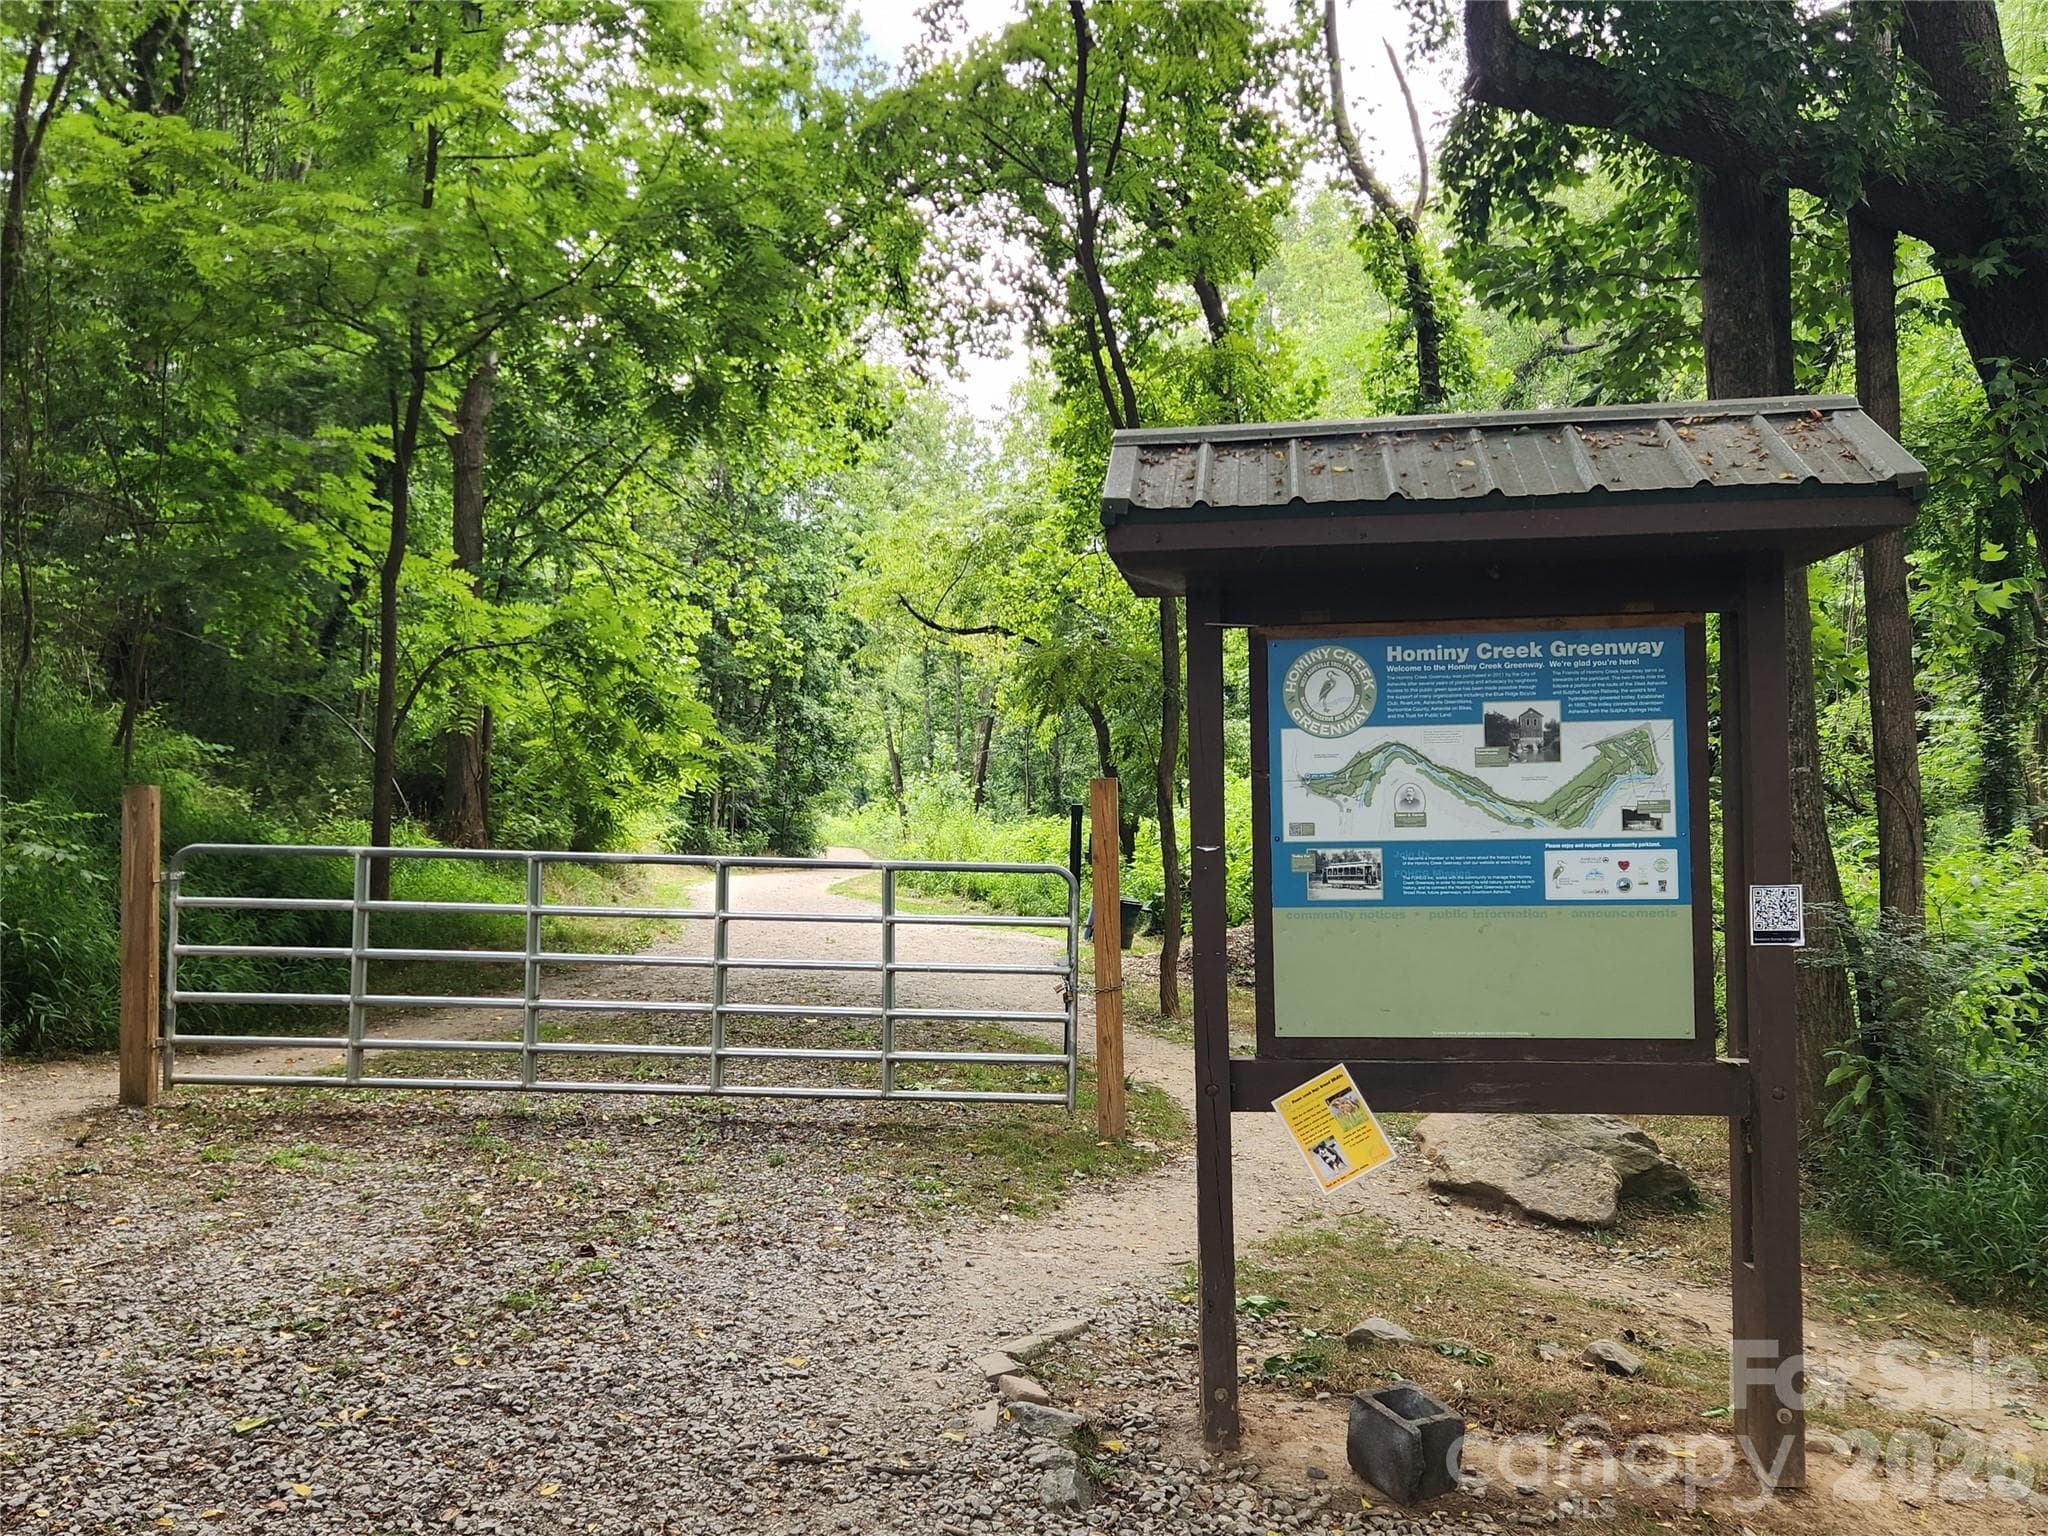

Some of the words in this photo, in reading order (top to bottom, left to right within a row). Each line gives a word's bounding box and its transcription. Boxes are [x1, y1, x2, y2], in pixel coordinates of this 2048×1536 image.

[1386, 644, 1469, 663] Hominy
[1476, 642, 1543, 660] Creek
[1550, 640, 1664, 657] Greenway
[1285, 648, 1331, 692] HOMINY
[1333, 649, 1375, 690] CREEK
[1386, 664, 1421, 673] Welcome
[1448, 663, 1477, 672] Hominy
[1479, 662, 1502, 670] Creek
[1504, 662, 1545, 670] Greenway.
[1549, 660, 1572, 668] We're
[1573, 659, 1591, 668] glad
[1592, 658, 1617, 668] you're
[1619, 658, 1640, 666] here!
[1291, 704, 1369, 735] GREENWAY
[1286, 910, 1355, 921] community
[1360, 910, 1406, 919] notices
[1429, 909, 1469, 920] public
[1472, 909, 1548, 919] information
[1571, 909, 1679, 919] announcements
